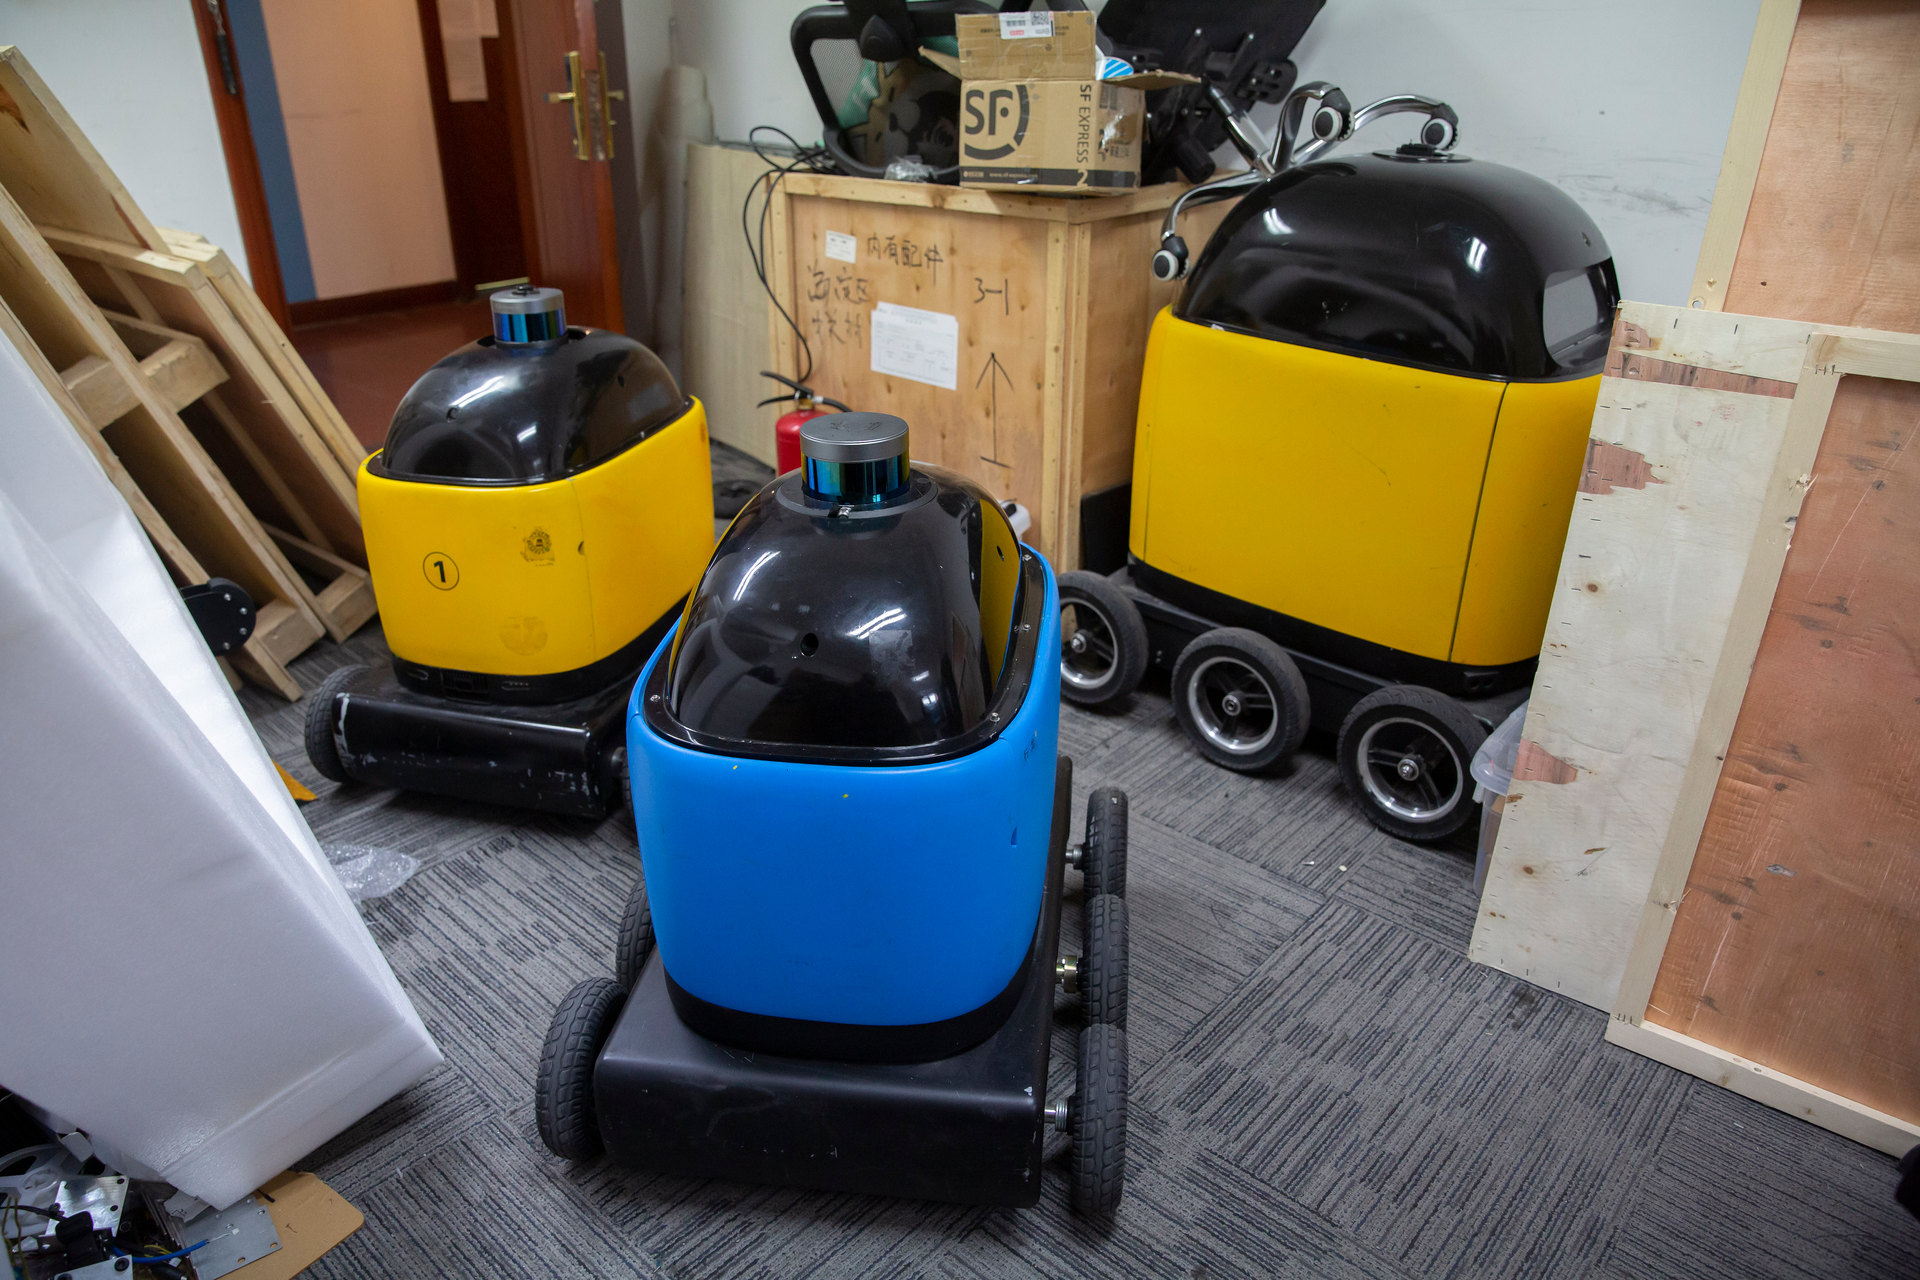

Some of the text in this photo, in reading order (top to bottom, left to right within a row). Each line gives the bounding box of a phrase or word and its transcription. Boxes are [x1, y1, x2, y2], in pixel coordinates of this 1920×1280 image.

[966, 90, 1013, 135] SF
[1076, 84, 1092, 163] SF EXPRESS
[1076, 169, 1089, 187] 2
[867, 233, 944, 285] 内有配件
[973, 277, 1009, 316] 3-1
[435, 562, 446, 582] 1
